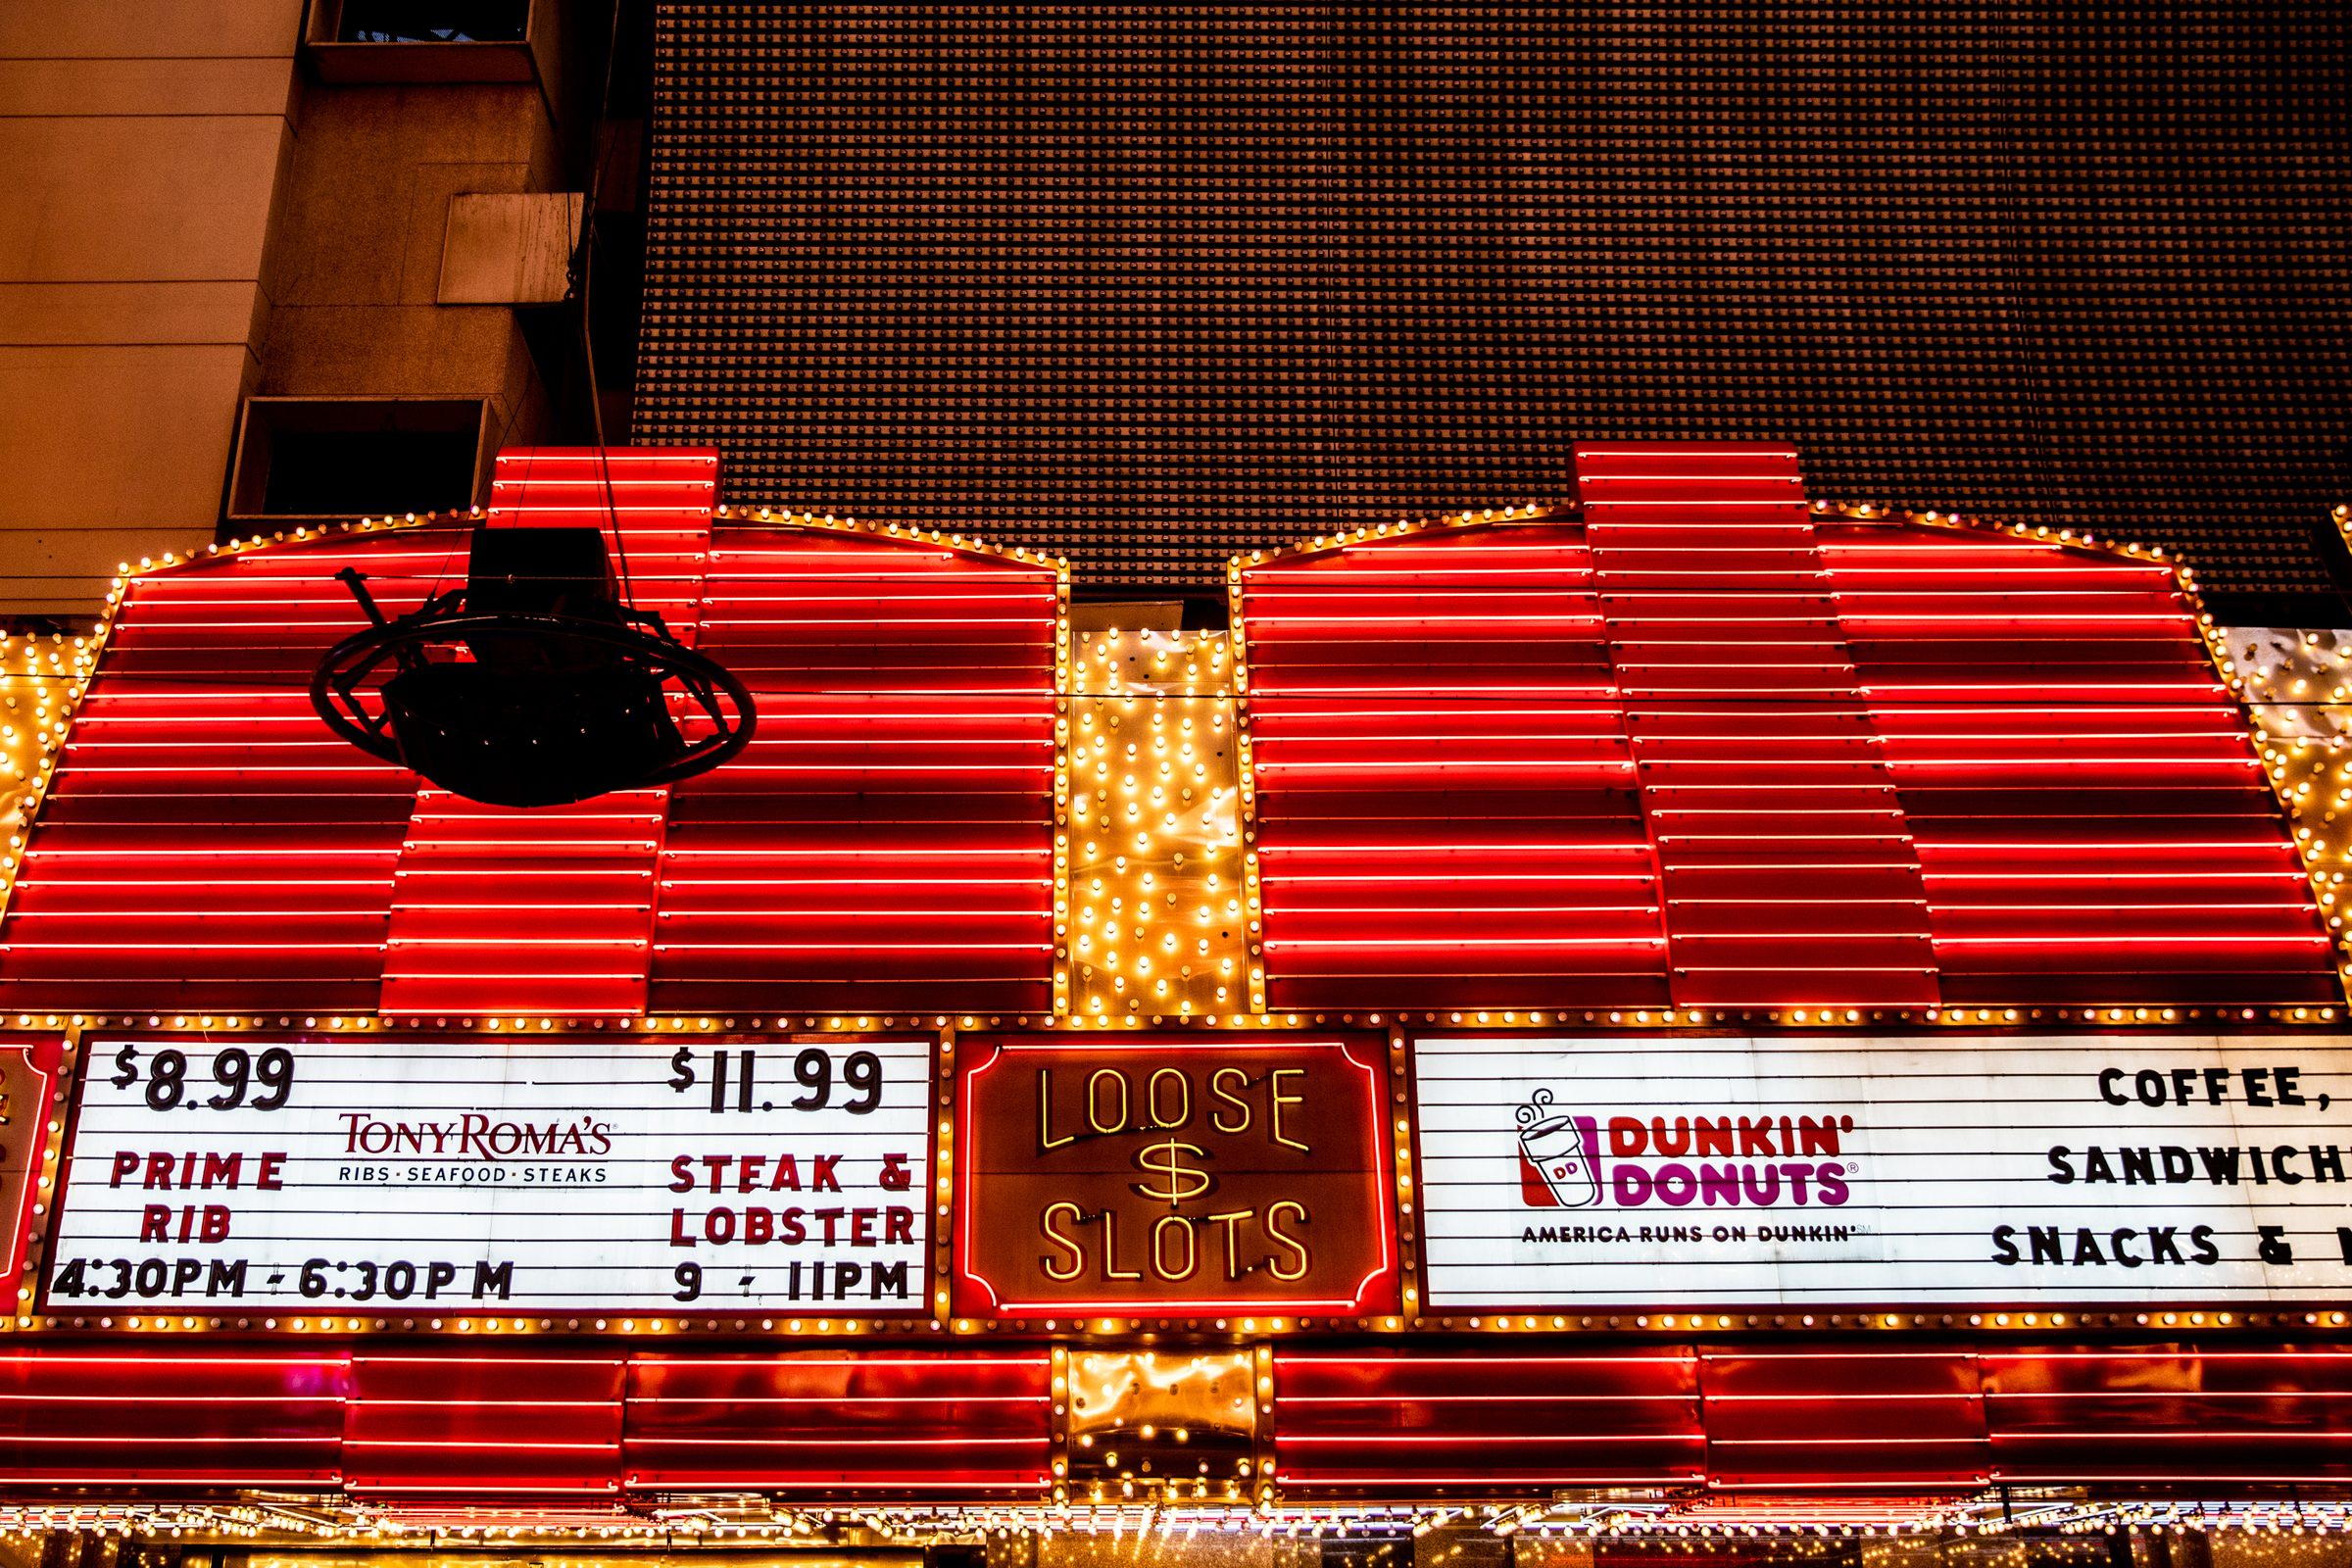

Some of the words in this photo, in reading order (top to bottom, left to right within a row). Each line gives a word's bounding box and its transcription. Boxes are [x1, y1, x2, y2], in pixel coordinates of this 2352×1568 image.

[110, 1045, 295, 1112] $8.99
[667, 1046, 883, 1115] $11.99
[2098, 1066, 2330, 1112] COFFEE,
[1036, 1066, 1309, 1158] LOOSE
[1608, 1115, 1854, 1158] DUNKIN'
[110, 1151, 287, 1191] PRIME
[339, 1166, 390, 1181] RIBS
[407, 1166, 506, 1182] SEAFOOD
[523, 1167, 607, 1182] STEAKS
[668, 1153, 844, 1194] STEAK
[879, 1152, 911, 1192] &
[2047, 1145, 2352, 1186] SANDWICH
[139, 1203, 231, 1244] RIB
[669, 1205, 914, 1248] LOBSTER
[1039, 1200, 1313, 1283] SLOTS
[1522, 1226, 1631, 1243] AMERICA
[1640, 1226, 1703, 1243] RUNS
[1712, 1226, 1746, 1243] ON
[1991, 1225, 2220, 1268] SNACKS
[2258, 1225, 2293, 1265] &
[52, 1257, 248, 1298] 4:30PM
[299, 1257, 514, 1300] 6:30PM
[672, 1261, 703, 1301] 9
[788, 1261, 908, 1300] 11PM
